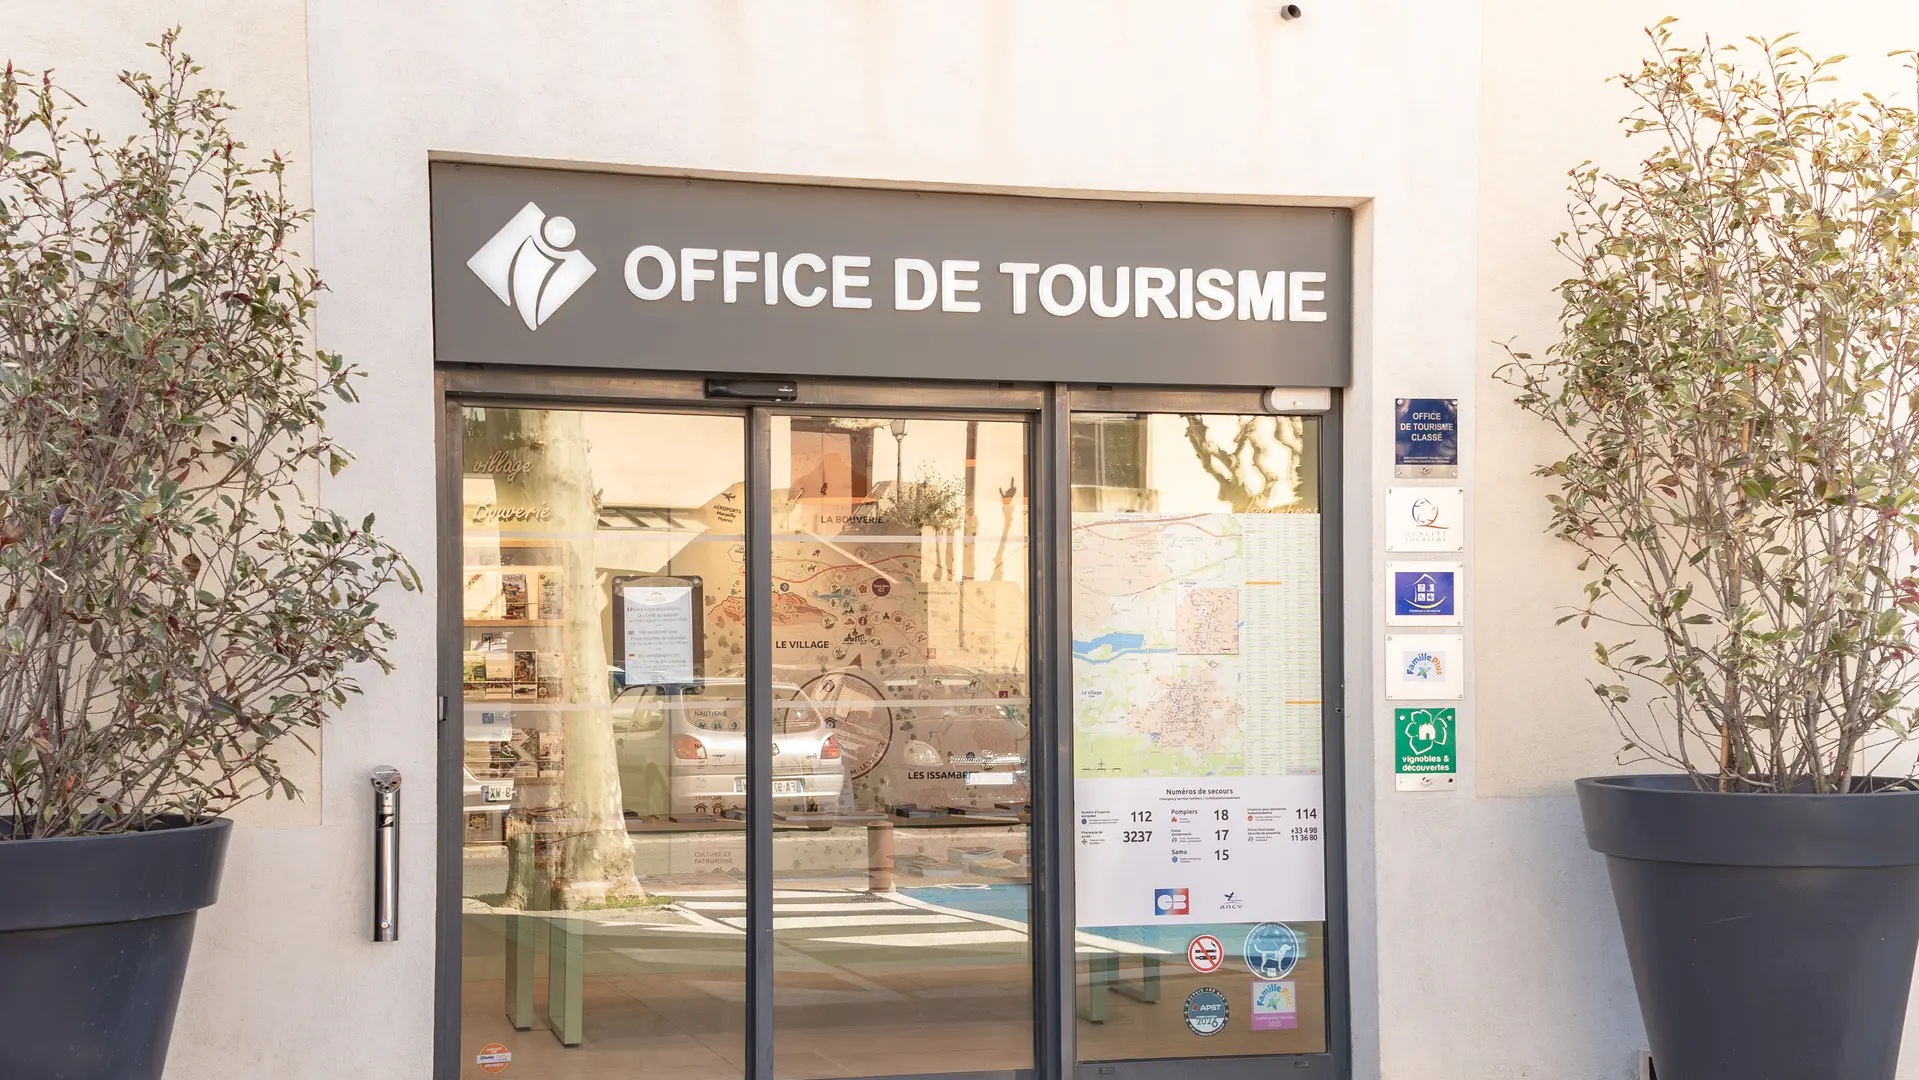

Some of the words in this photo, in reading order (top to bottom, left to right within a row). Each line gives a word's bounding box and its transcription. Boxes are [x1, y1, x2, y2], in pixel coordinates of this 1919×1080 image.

[624, 244, 873, 309] OFFICE
[894, 257, 982, 313] DE
[999, 262, 1328, 322] TOURISME
[1412, 412, 1442, 421] OFFICE
[1400, 423, 1412, 431] DE
[1413, 423, 1454, 431] TOURISME
[1411, 432, 1443, 442] CLASSÉ
[472, 450, 532, 482] village
[820, 515, 834, 525] LA
[836, 515, 884, 525] BOUVERIE
[775, 641, 788, 649] LE
[790, 640, 830, 649] VILLAGE
[1406, 652, 1432, 675] Famille
[1088, 689, 1102, 697] Village
[1402, 756, 1441, 764] vignobles
[1443, 755, 1450, 763] &
[1402, 762, 1450, 771] découvertes
[908, 771, 925, 780] LES
[927, 770, 980, 780] ISSAMBR
[1131, 811, 1152, 822] 112
[1213, 809, 1229, 821] 18
[1296, 808, 1317, 820] 114
[1123, 831, 1152, 842] 3237
[1214, 829, 1229, 841] 17
[1214, 849, 1230, 861] 15
[1256, 983, 1281, 1006] Famille
[1200, 1004, 1222, 1012] APST
[1196, 1017, 1219, 1028] 2026
